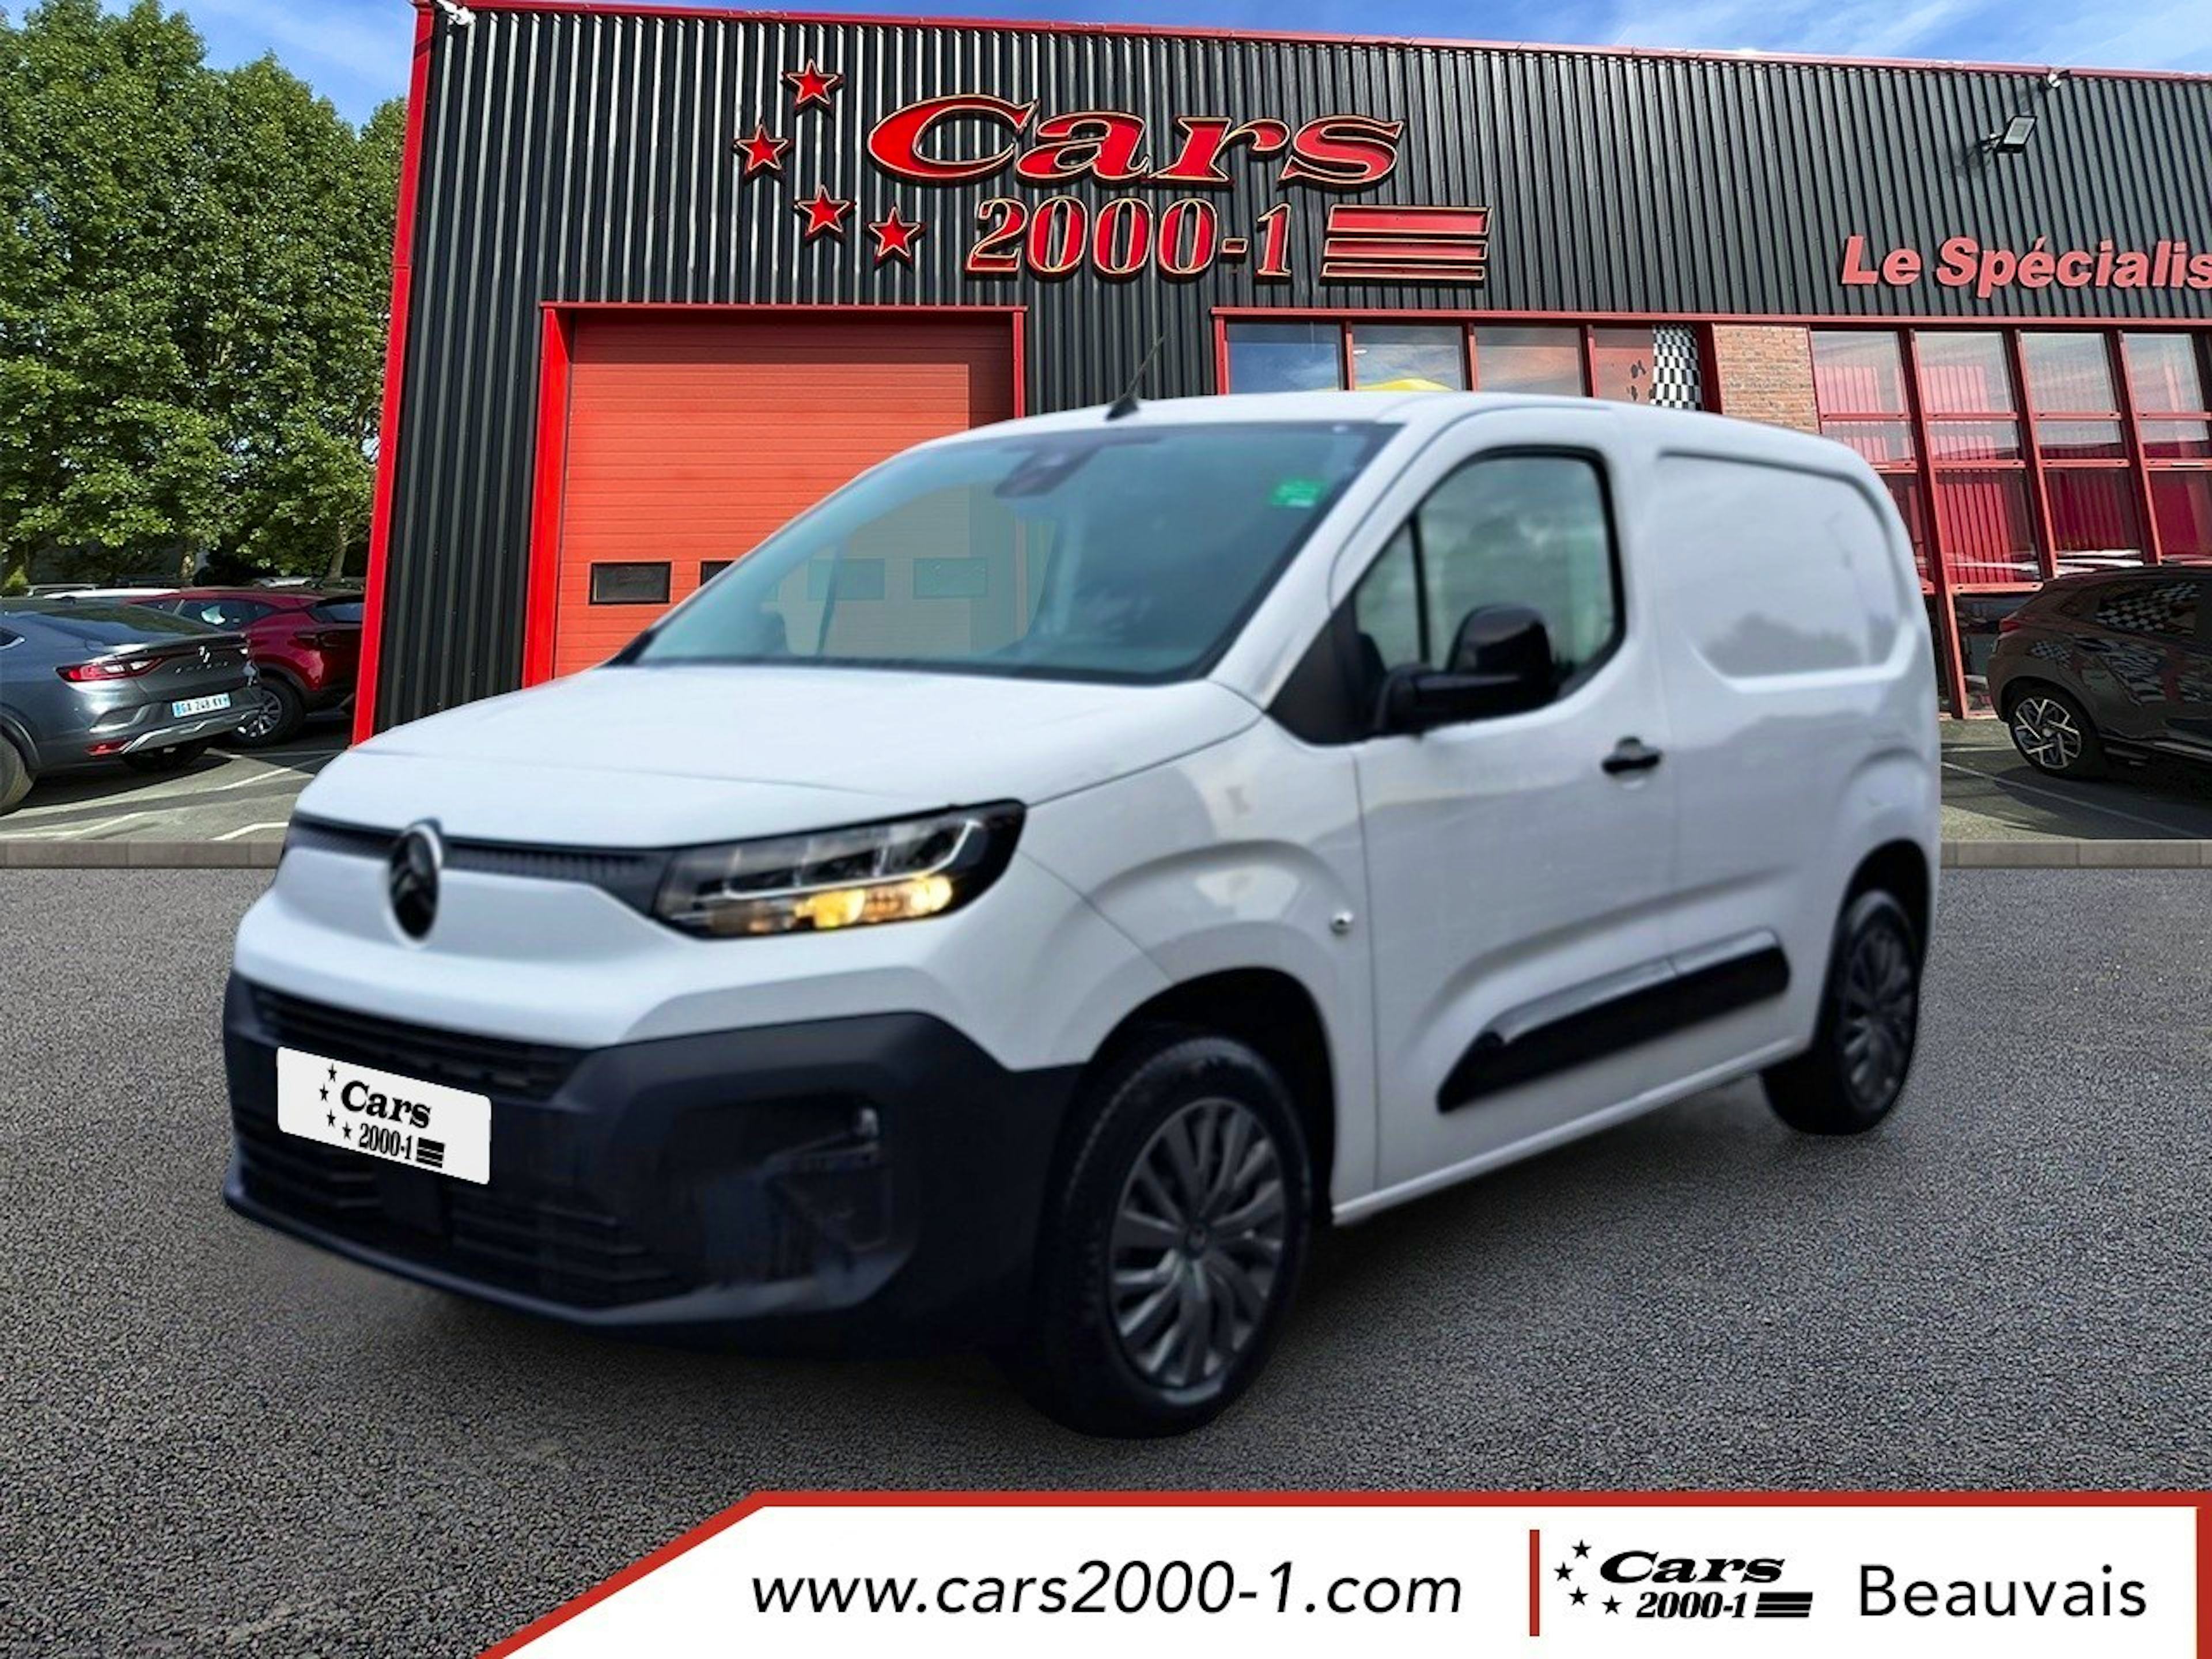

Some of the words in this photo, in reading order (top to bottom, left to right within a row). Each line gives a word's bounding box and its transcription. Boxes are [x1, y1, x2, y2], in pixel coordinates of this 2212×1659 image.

[867, 93, 1404, 188] Cars
[965, 197, 1291, 282] 2000-1
[1842, 235, 1921, 285] Le
[1937, 235, 2212, 298] Spécialis
[341, 1081, 431, 1128] Cars
[359, 1123, 412, 1160] 2000-1
